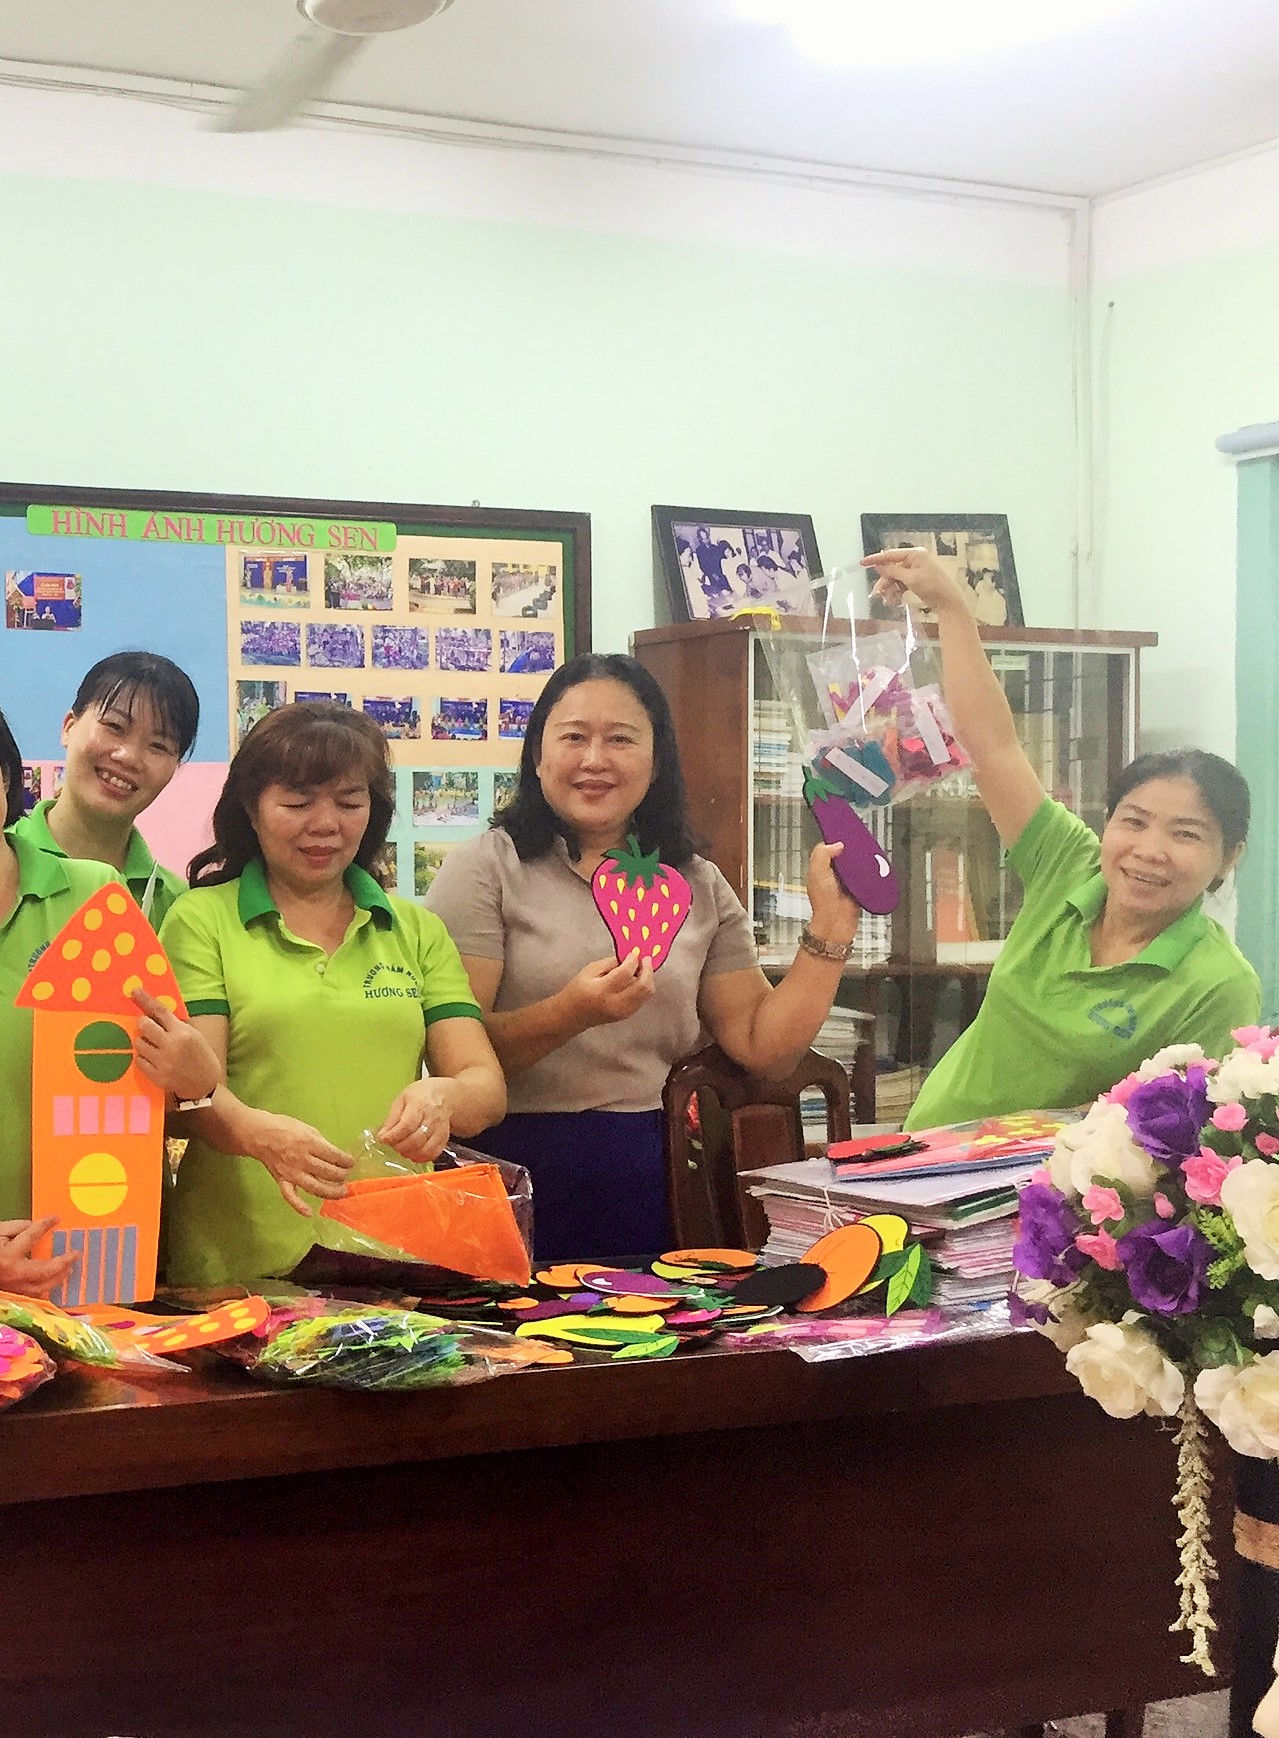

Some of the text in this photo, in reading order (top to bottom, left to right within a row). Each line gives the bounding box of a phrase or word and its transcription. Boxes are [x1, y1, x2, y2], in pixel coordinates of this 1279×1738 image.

[52, 507, 128, 537] HÌNH
[216, 518, 315, 547] HƯƠNG
[328, 524, 377, 550] SEN
